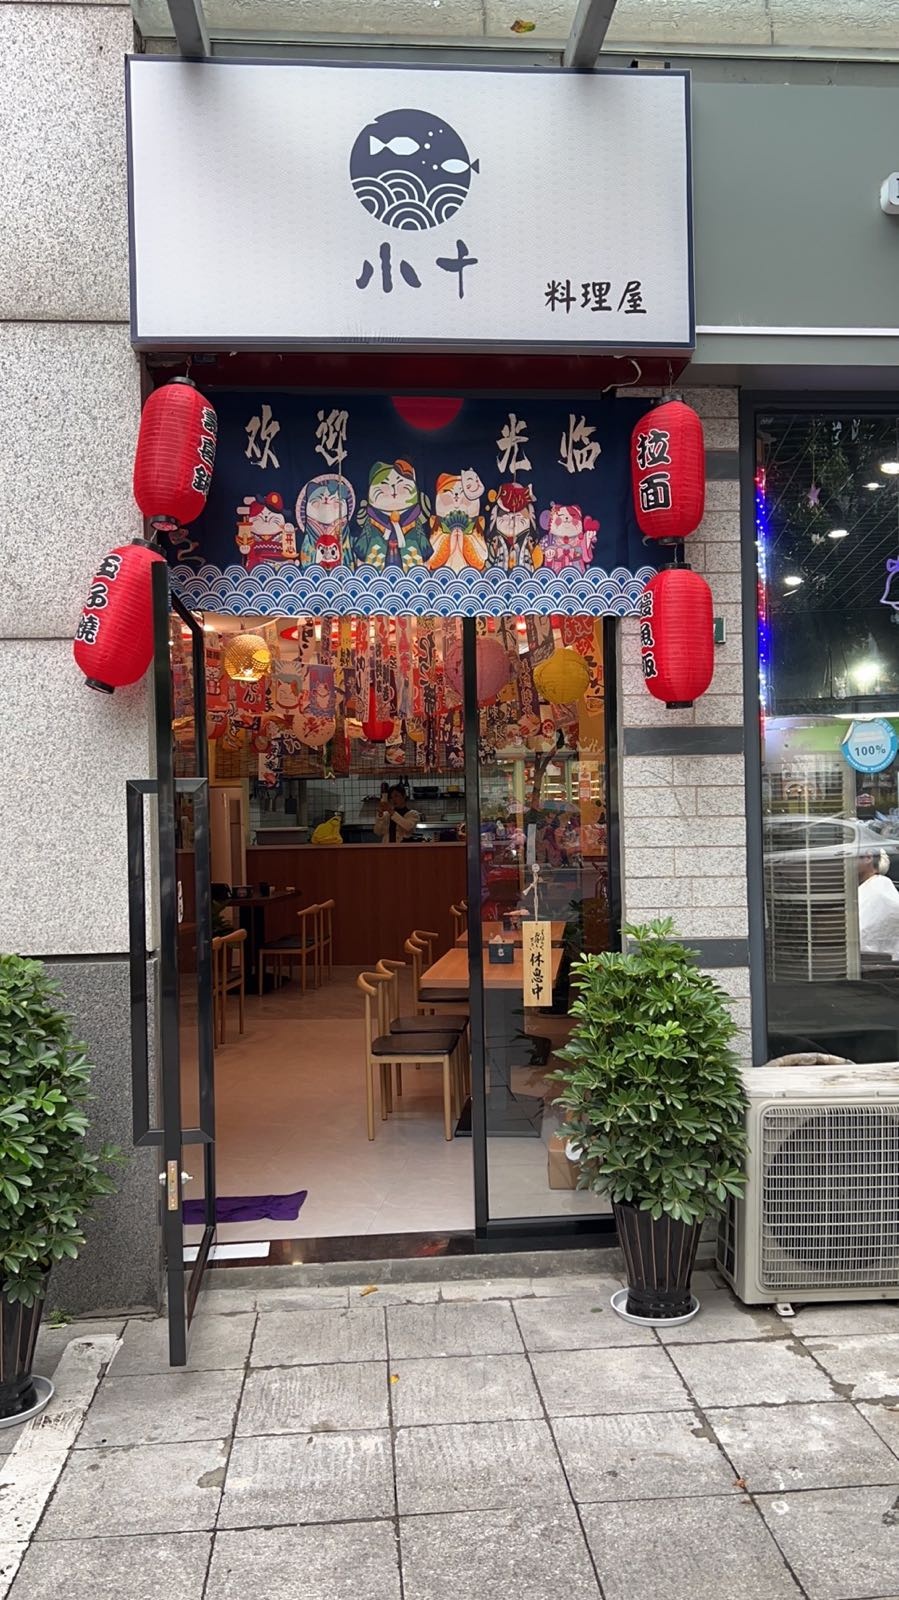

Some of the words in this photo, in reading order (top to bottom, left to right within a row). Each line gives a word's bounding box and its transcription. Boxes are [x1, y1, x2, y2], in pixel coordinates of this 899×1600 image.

[355, 239, 479, 299] 小十
[543, 279, 648, 314] 料理屋
[636, 429, 672, 512] 拉面
[854, 743, 886, 757] 100%
[529, 952, 545, 1001] 休息中
